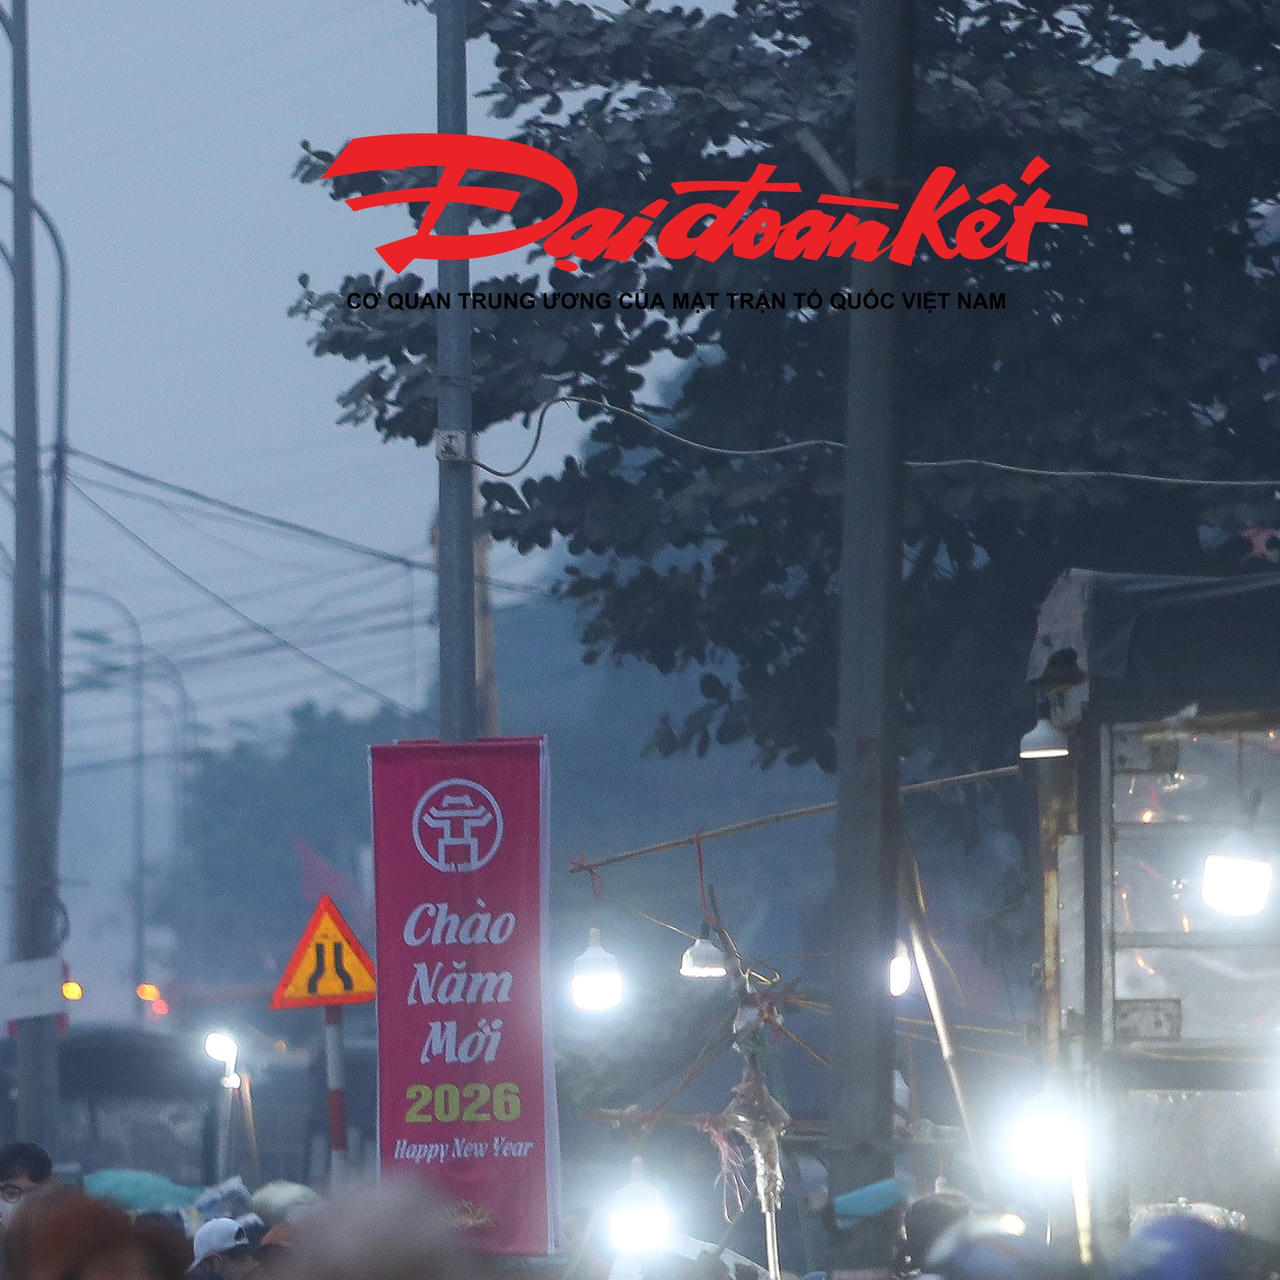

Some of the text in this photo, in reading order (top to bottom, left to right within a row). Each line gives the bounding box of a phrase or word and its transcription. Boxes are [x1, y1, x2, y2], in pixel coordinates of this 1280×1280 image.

[403, 897, 517, 946] Chào
[407, 959, 514, 1005] Năm
[420, 1018, 504, 1065] Mới
[406, 1082, 522, 1123] 2026
[394, 1135, 536, 1164] Happy New Year
